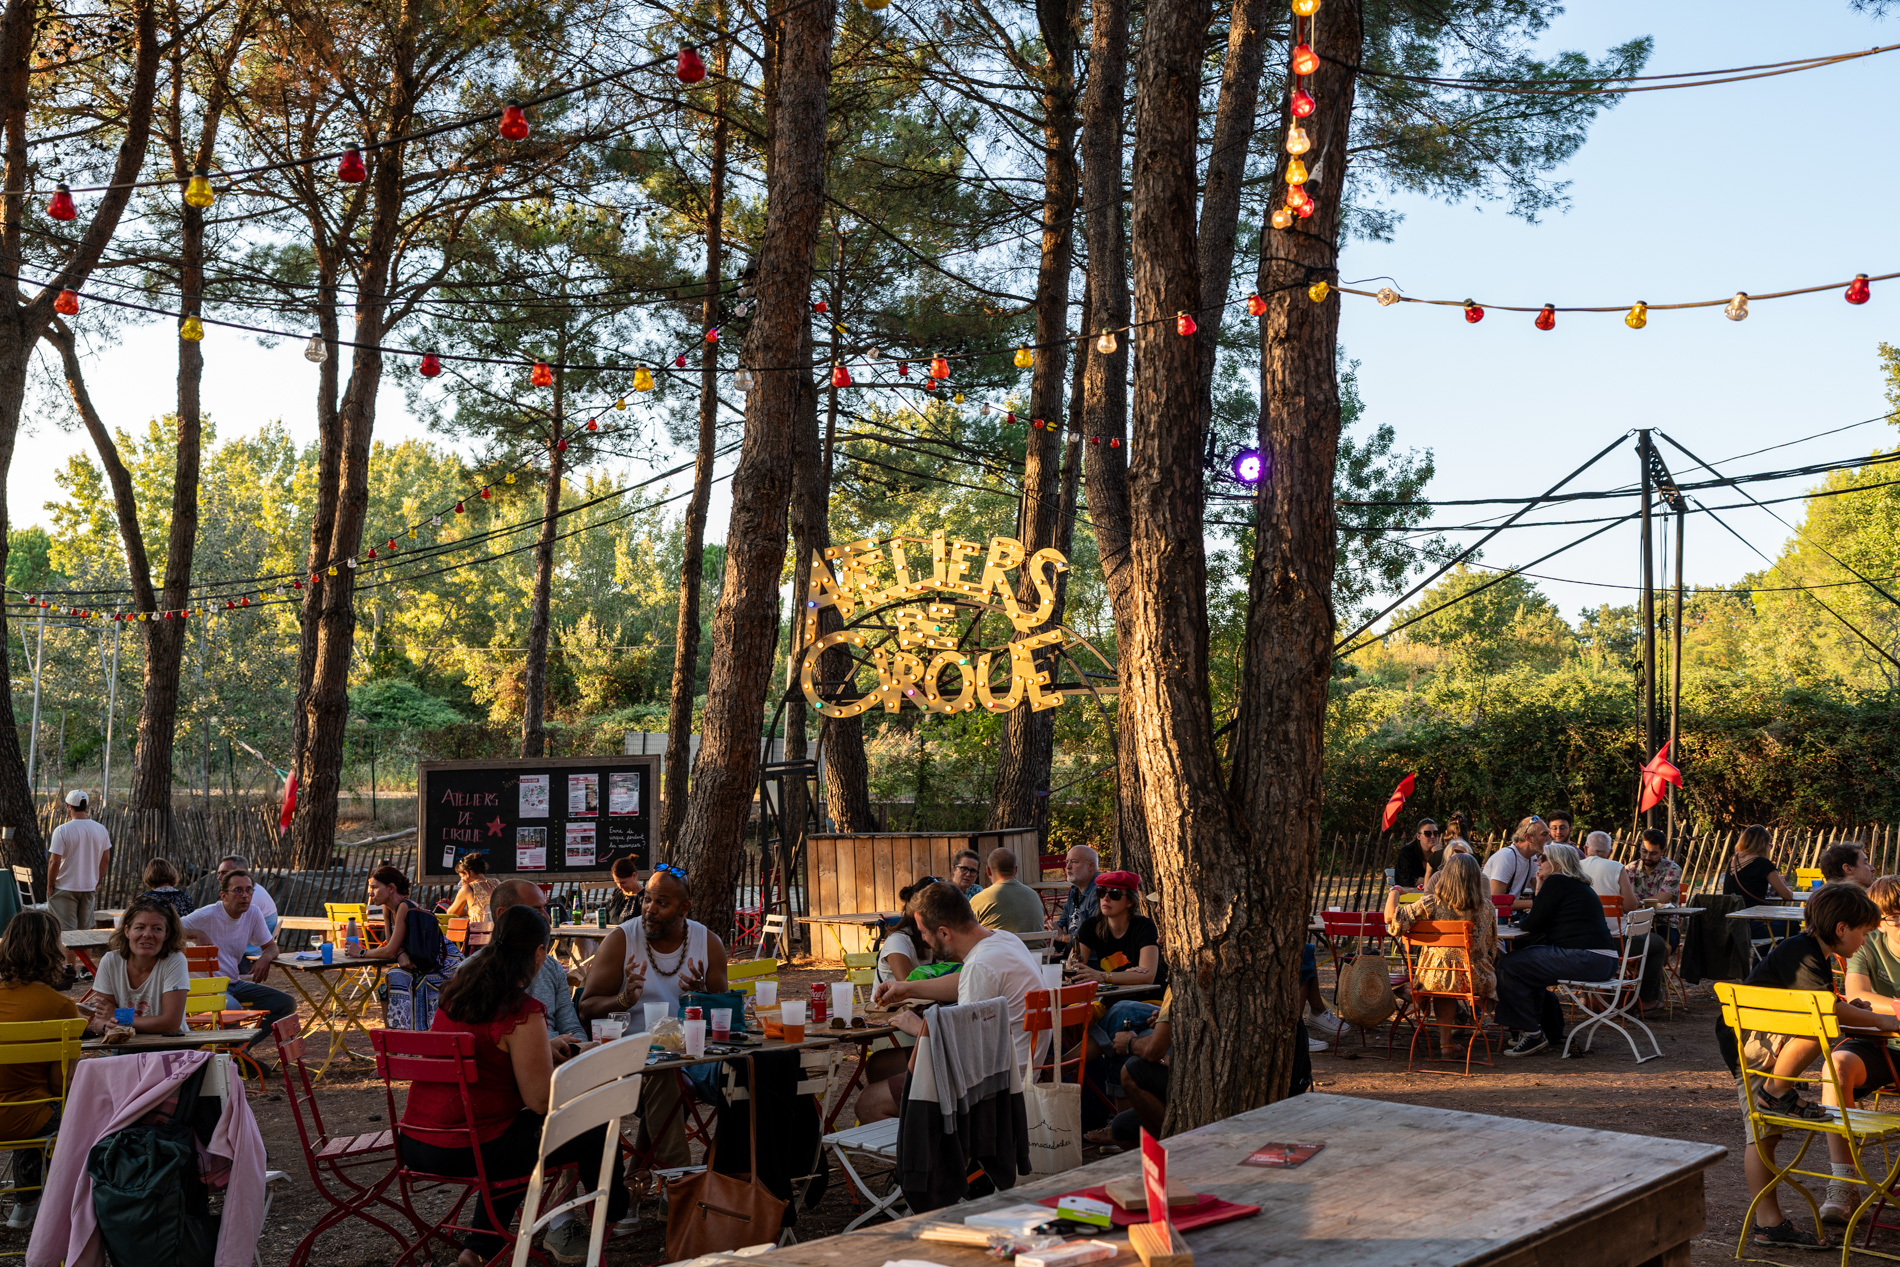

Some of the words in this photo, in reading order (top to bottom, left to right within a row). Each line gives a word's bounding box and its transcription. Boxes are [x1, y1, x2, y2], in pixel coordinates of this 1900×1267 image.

[803, 529, 1069, 648] ATELIERS
[897, 604, 958, 650] DE
[801, 629, 1064, 718] CIRQUE
[441, 788, 499, 807] ATELIERS
[457, 810, 475, 826] DE
[442, 827, 484, 843] CIRQUE
